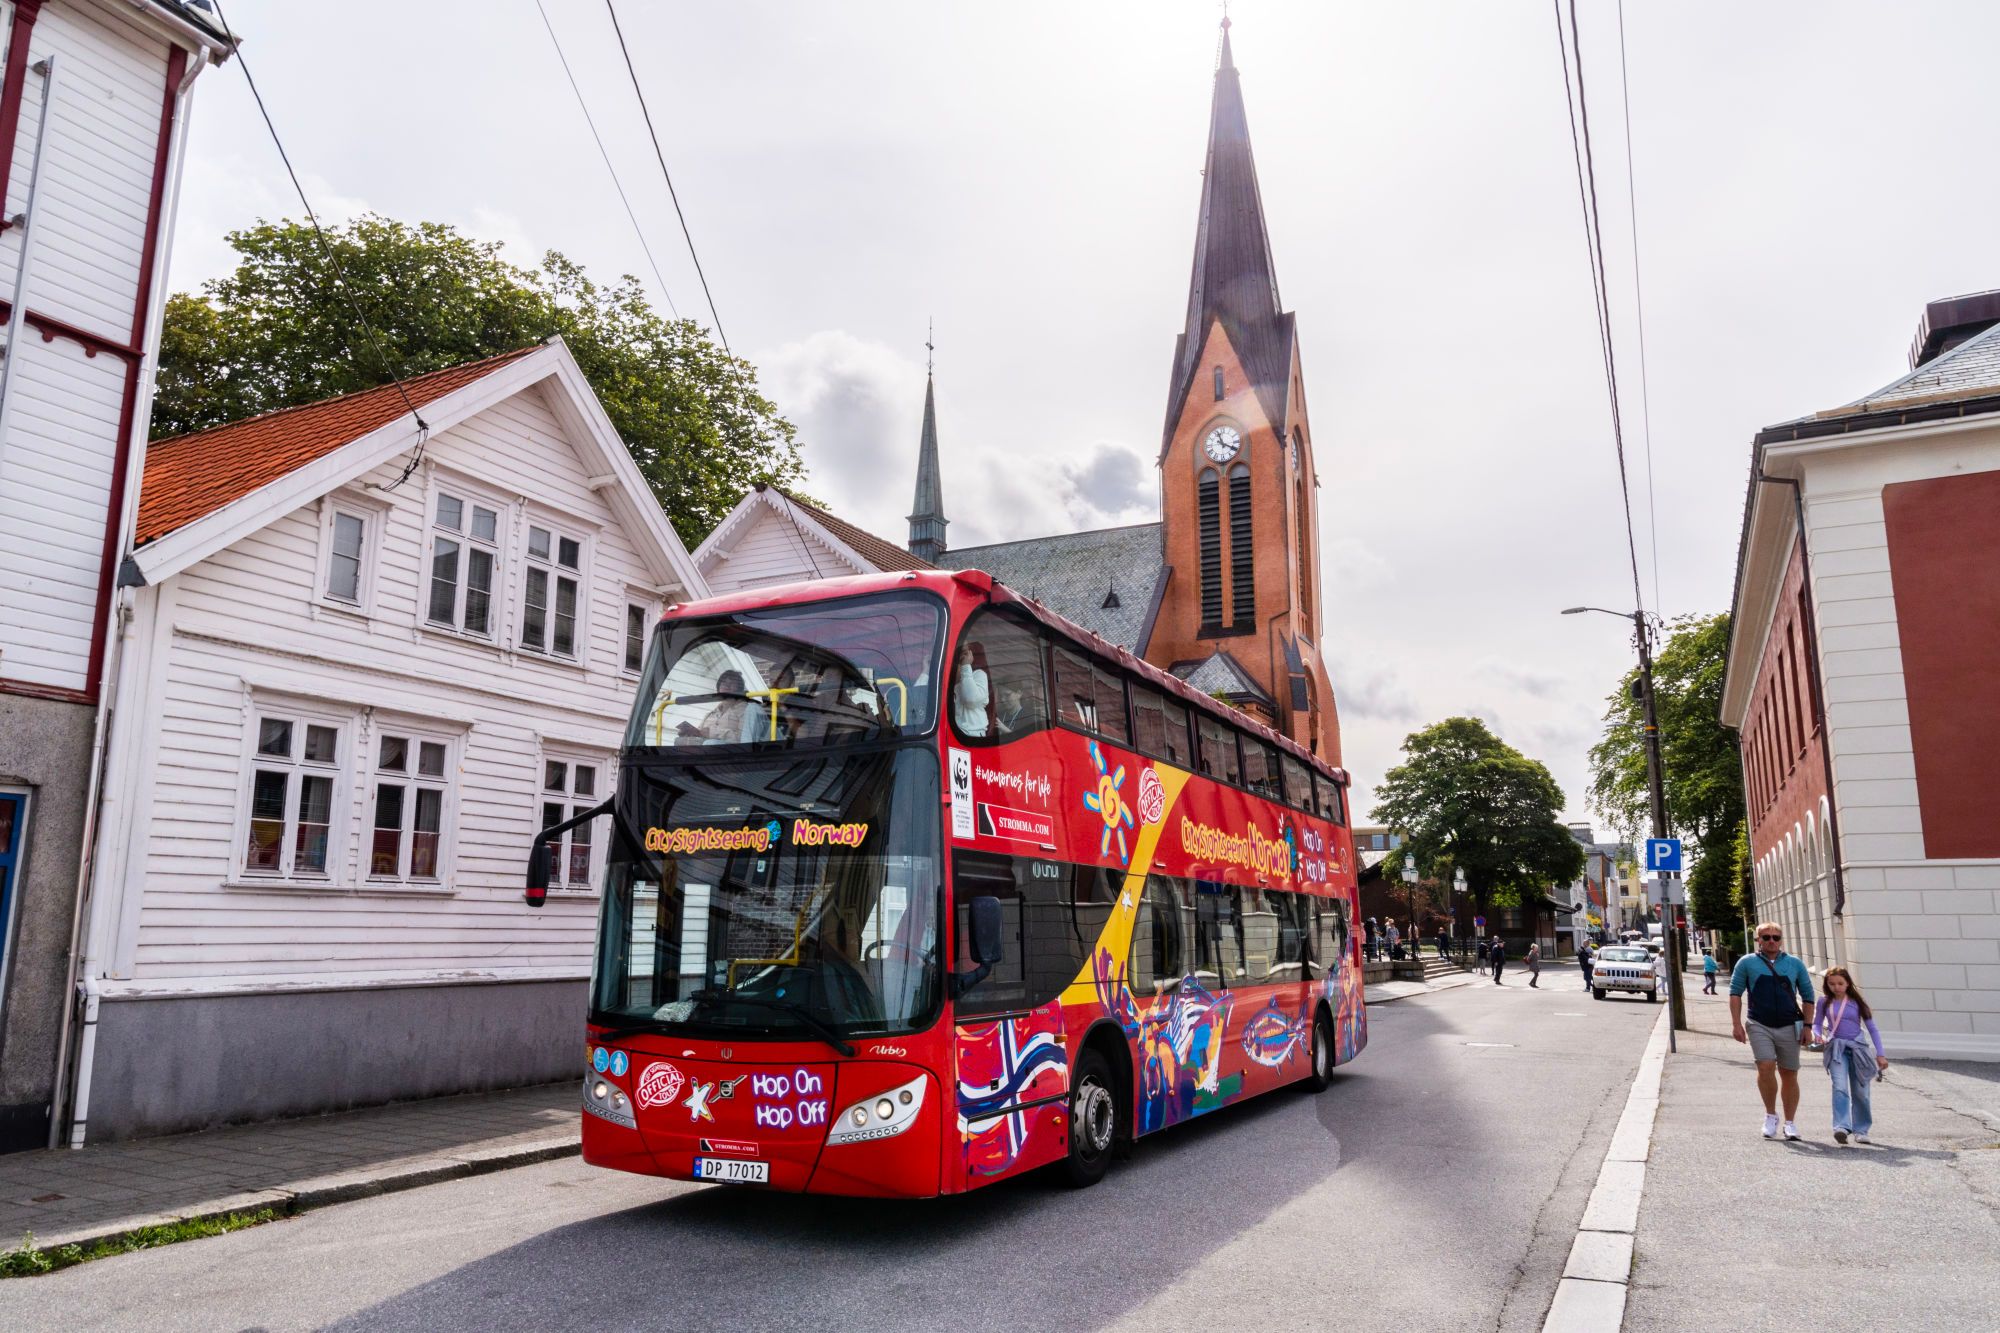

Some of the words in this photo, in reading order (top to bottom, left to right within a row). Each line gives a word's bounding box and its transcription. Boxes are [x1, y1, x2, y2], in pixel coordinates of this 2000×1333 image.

[954, 791, 969, 802] WWF
[1025, 769, 1037, 805] for
[1038, 774, 1051, 808] life
[792, 818, 869, 848] Norway
[1302, 827, 1314, 853] Hop
[1314, 829, 1323, 853] On
[1247, 820, 1291, 883] Norway
[1654, 843, 1672, 867] P
[1305, 858, 1318, 883] Hop
[869, 1045, 907, 1058] Urbis
[640, 1072, 683, 1101] OFFICIAL
[659, 1086, 676, 1100] TOUR
[753, 1074, 790, 1098] Hop
[795, 1069, 821, 1094] On
[756, 1105, 793, 1128] Hop
[798, 1101, 827, 1125] Off
[706, 1161, 722, 1176] DP
[728, 1163, 763, 1180] 17012
